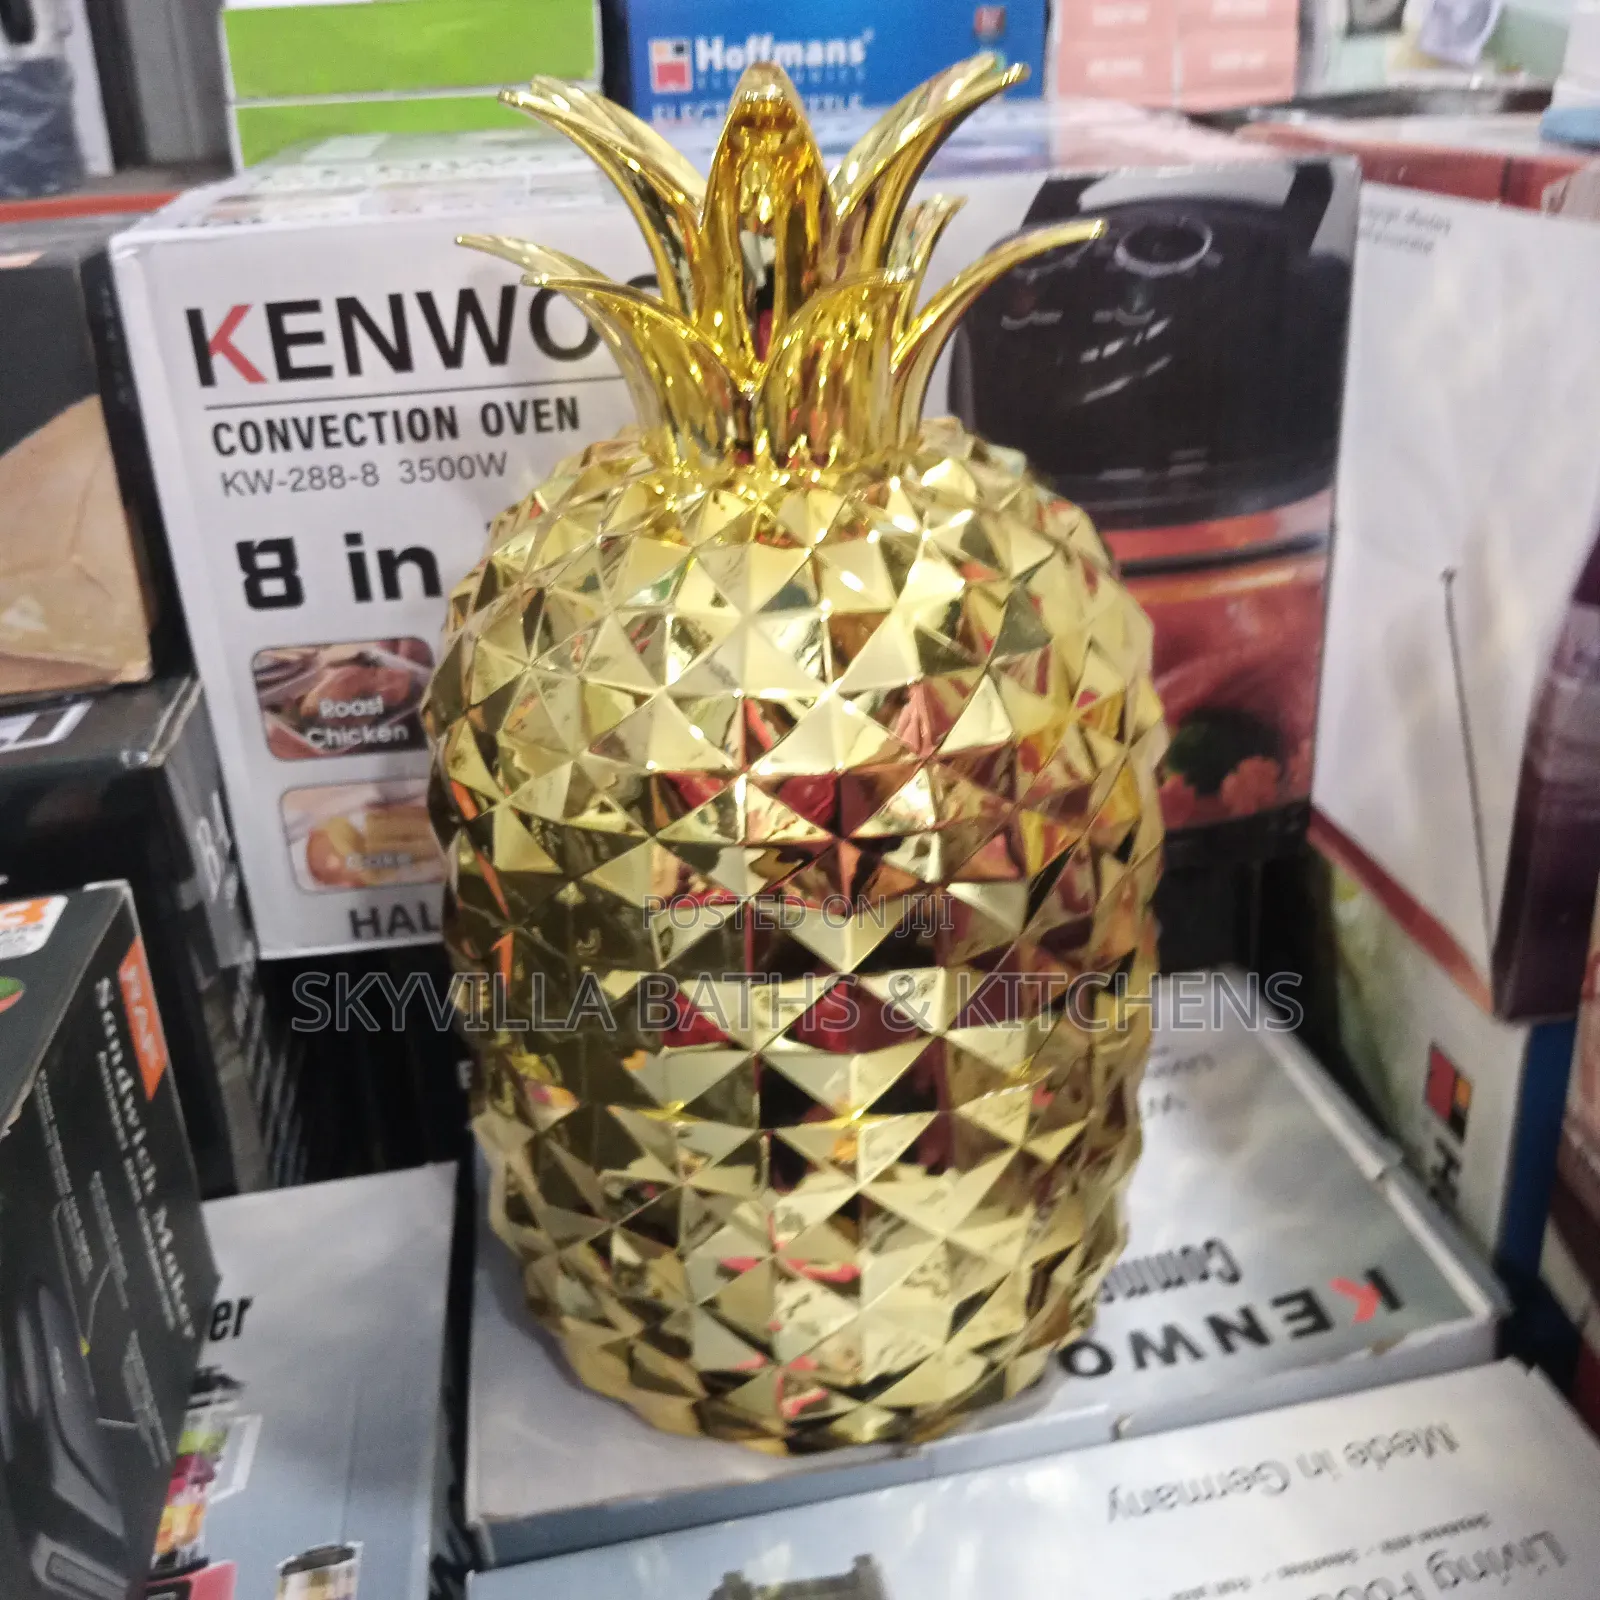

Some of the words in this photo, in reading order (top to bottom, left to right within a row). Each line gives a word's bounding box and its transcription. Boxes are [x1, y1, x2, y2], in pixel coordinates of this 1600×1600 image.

[696, 33, 865, 72] Hoffmans
[186, 273, 657, 388] KENWO
[212, 406, 460, 456] CONVECTION
[481, 397, 580, 436] OVEN
[220, 461, 380, 498] KW-288-8
[400, 451, 508, 484] 3500W
[236, 536, 305, 611] 8
[344, 532, 443, 604] in
[305, 725, 409, 749] Chicken
[95, 977, 157, 1195] Sandwich
[152, 1207, 196, 1339] Maker
[1107, 1459, 1292, 1524] Germany
[1425, 1530, 1570, 1591] Living
